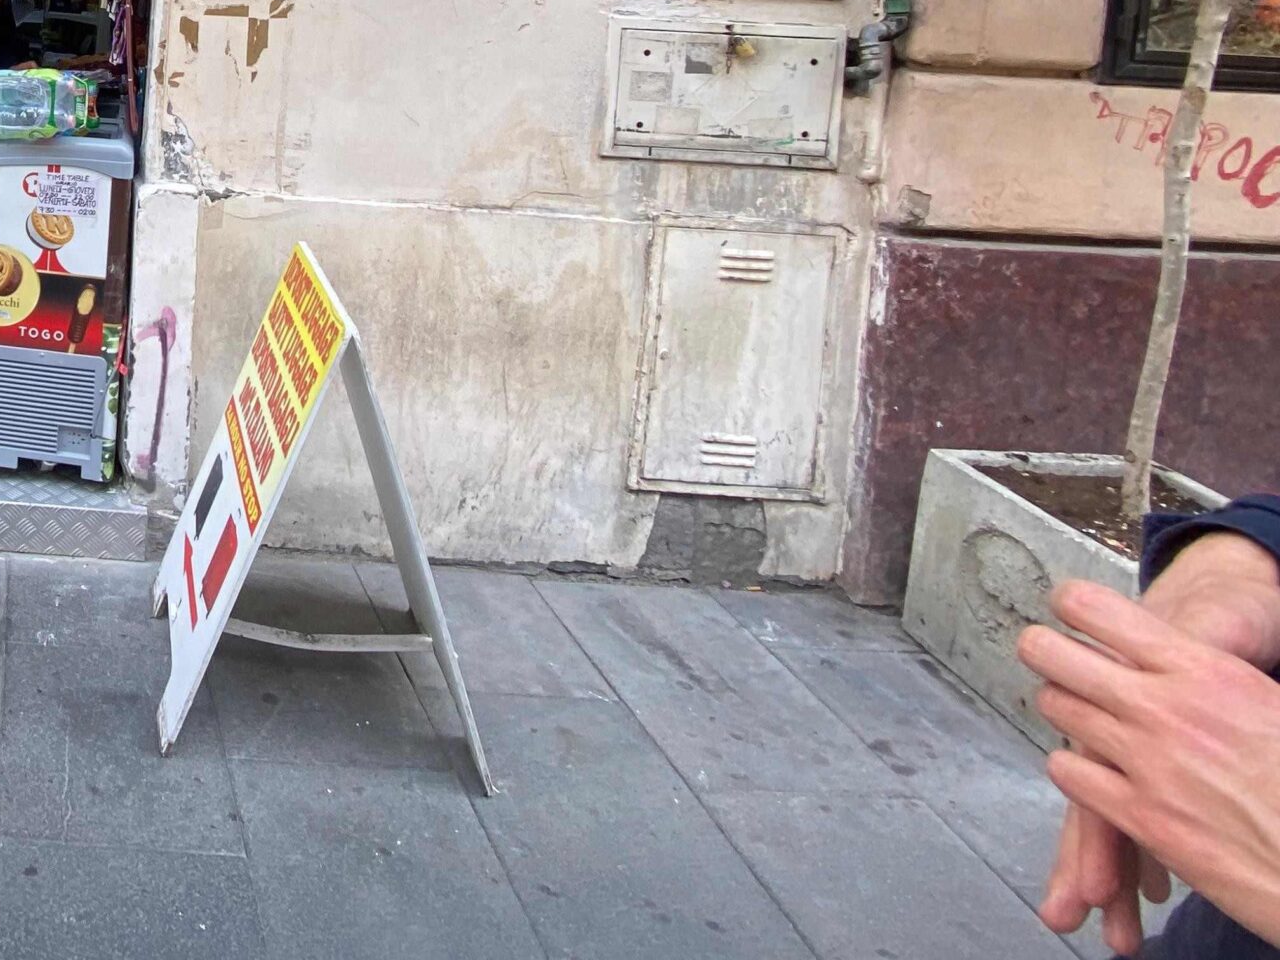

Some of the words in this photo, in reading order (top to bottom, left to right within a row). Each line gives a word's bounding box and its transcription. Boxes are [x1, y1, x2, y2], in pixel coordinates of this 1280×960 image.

[18, 325, 64, 342] TOGO
[300, 285, 340, 367] LUGGAGE
[281, 323, 319, 409] LUGGAGE
[243, 477, 259, 526] STOP
